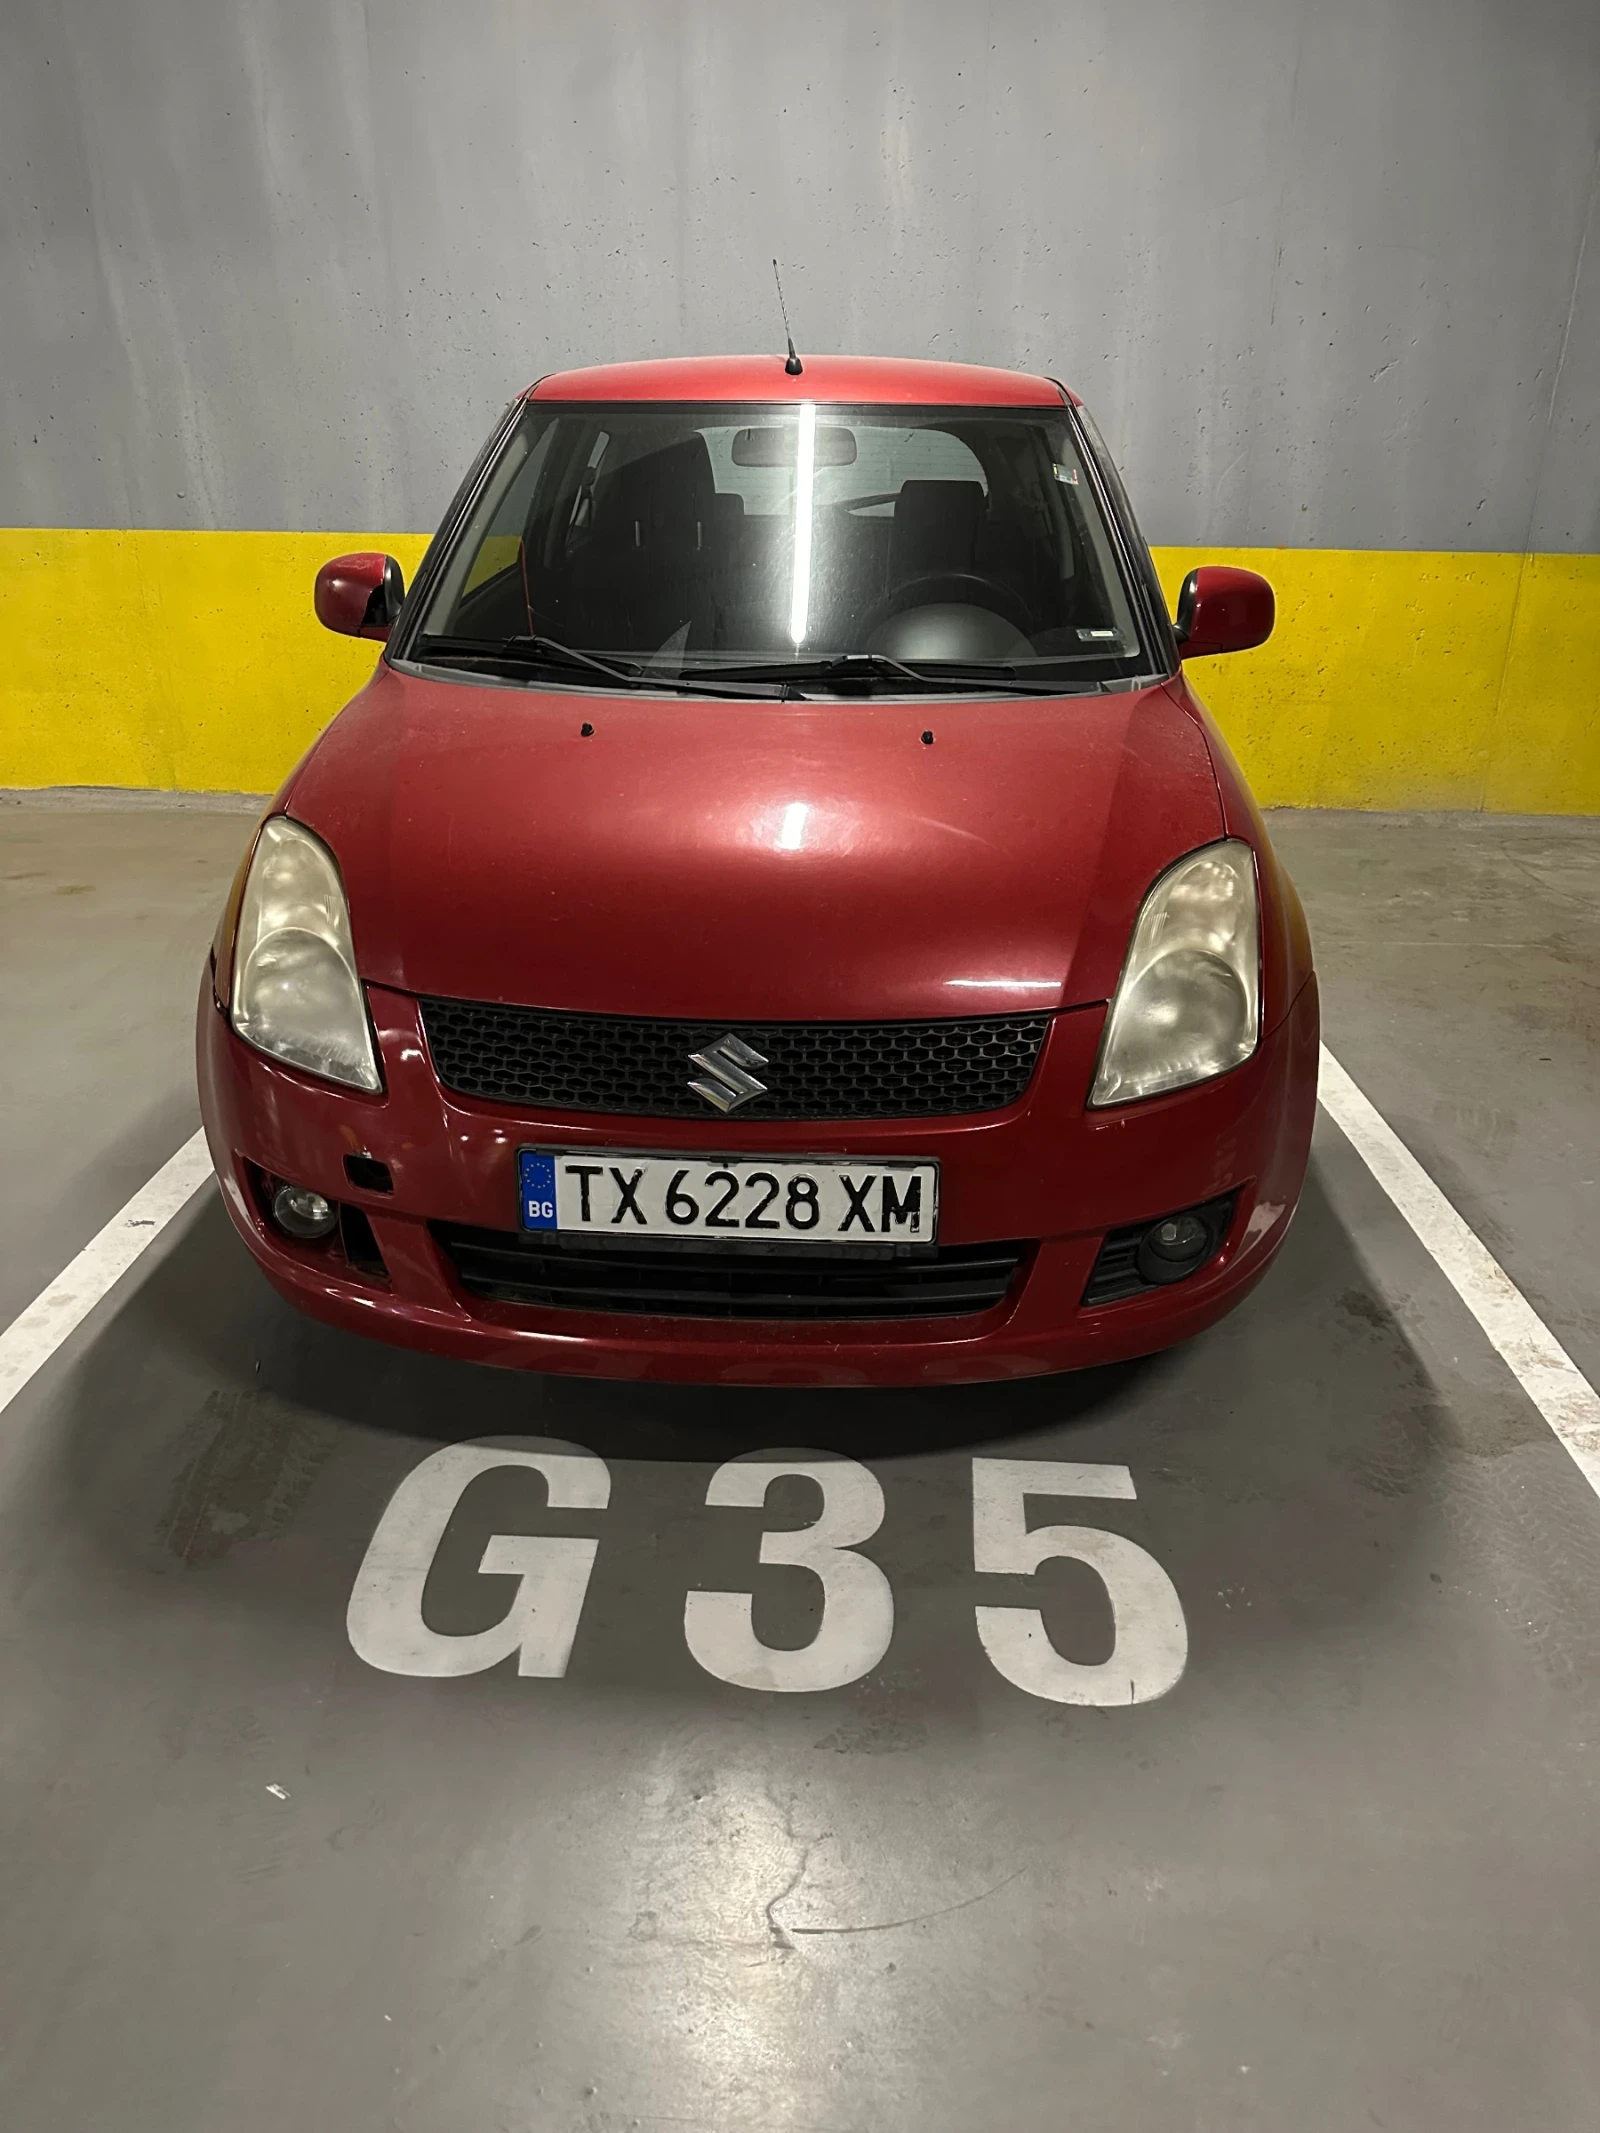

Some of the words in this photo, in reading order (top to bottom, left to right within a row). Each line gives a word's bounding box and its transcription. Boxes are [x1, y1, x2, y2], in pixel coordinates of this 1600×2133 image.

[528, 1200, 554, 1219] BG
[565, 1164, 648, 1225] TX
[665, 1169, 820, 1230] 6228
[837, 1174, 922, 1233] XM
